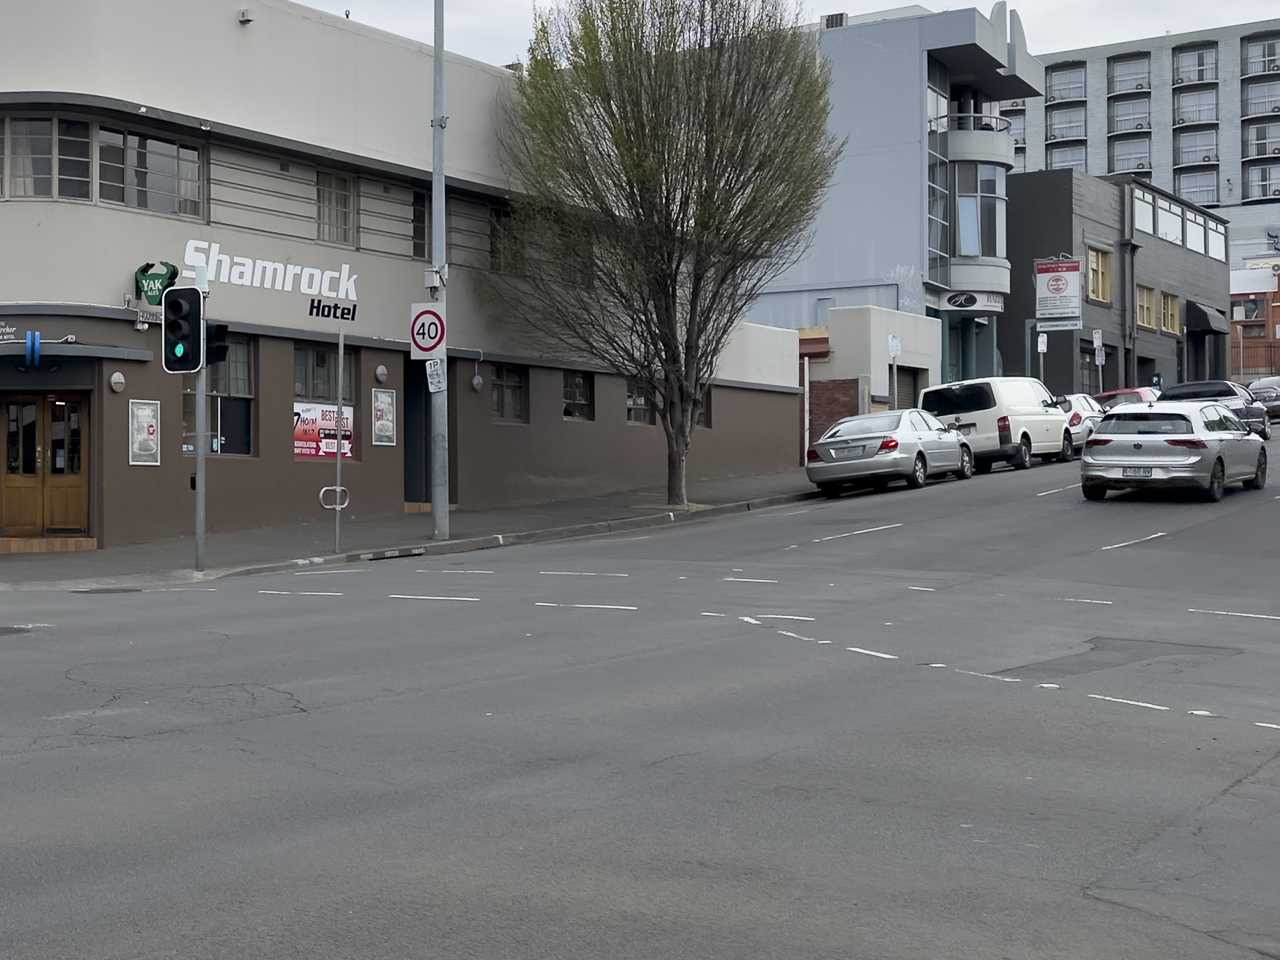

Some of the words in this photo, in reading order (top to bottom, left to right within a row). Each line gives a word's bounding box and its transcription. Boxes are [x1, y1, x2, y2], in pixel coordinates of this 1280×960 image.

[182, 239, 359, 301] Shamrock
[142, 278, 163, 291] YAK
[308, 298, 358, 322] Hotel
[415, 321, 439, 340] 40
[429, 360, 439, 370] 1P
[320, 409, 336, 422] BEST
